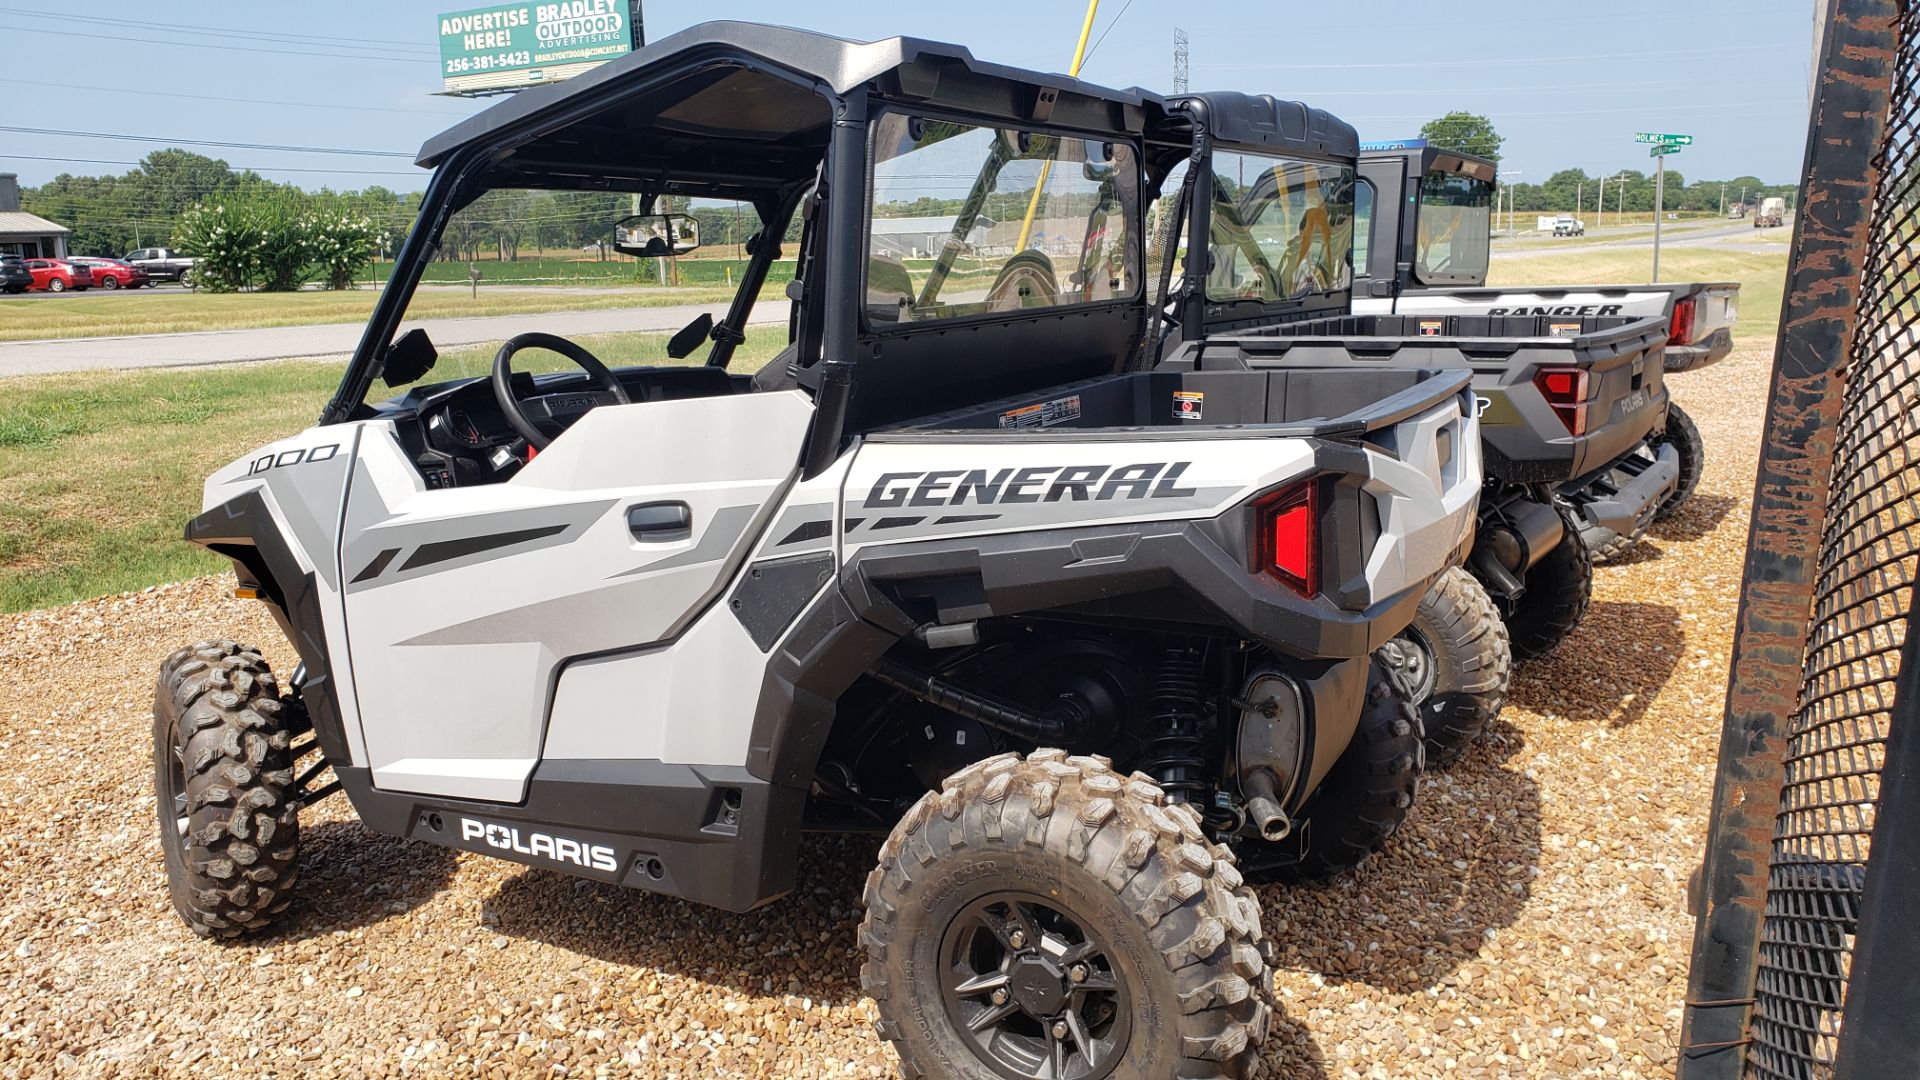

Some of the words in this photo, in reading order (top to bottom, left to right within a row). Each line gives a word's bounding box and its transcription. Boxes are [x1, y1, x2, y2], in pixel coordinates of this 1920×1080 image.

[441, 8, 529, 36] ADVERTISE
[536, 0, 616, 22] BRADLEY
[539, 15, 618, 39] OUTDOOR
[464, 28, 512, 51] HERE!
[539, 31, 620, 50] ADVERTISING
[446, 50, 531, 73] 256-381-5423
[1635, 132, 1665, 144] HOLMES
[1487, 304, 1623, 316] RANGER
[248, 443, 340, 477] 1000
[863, 461, 1198, 509] GENERAL
[461, 817, 618, 873] POLARIS
